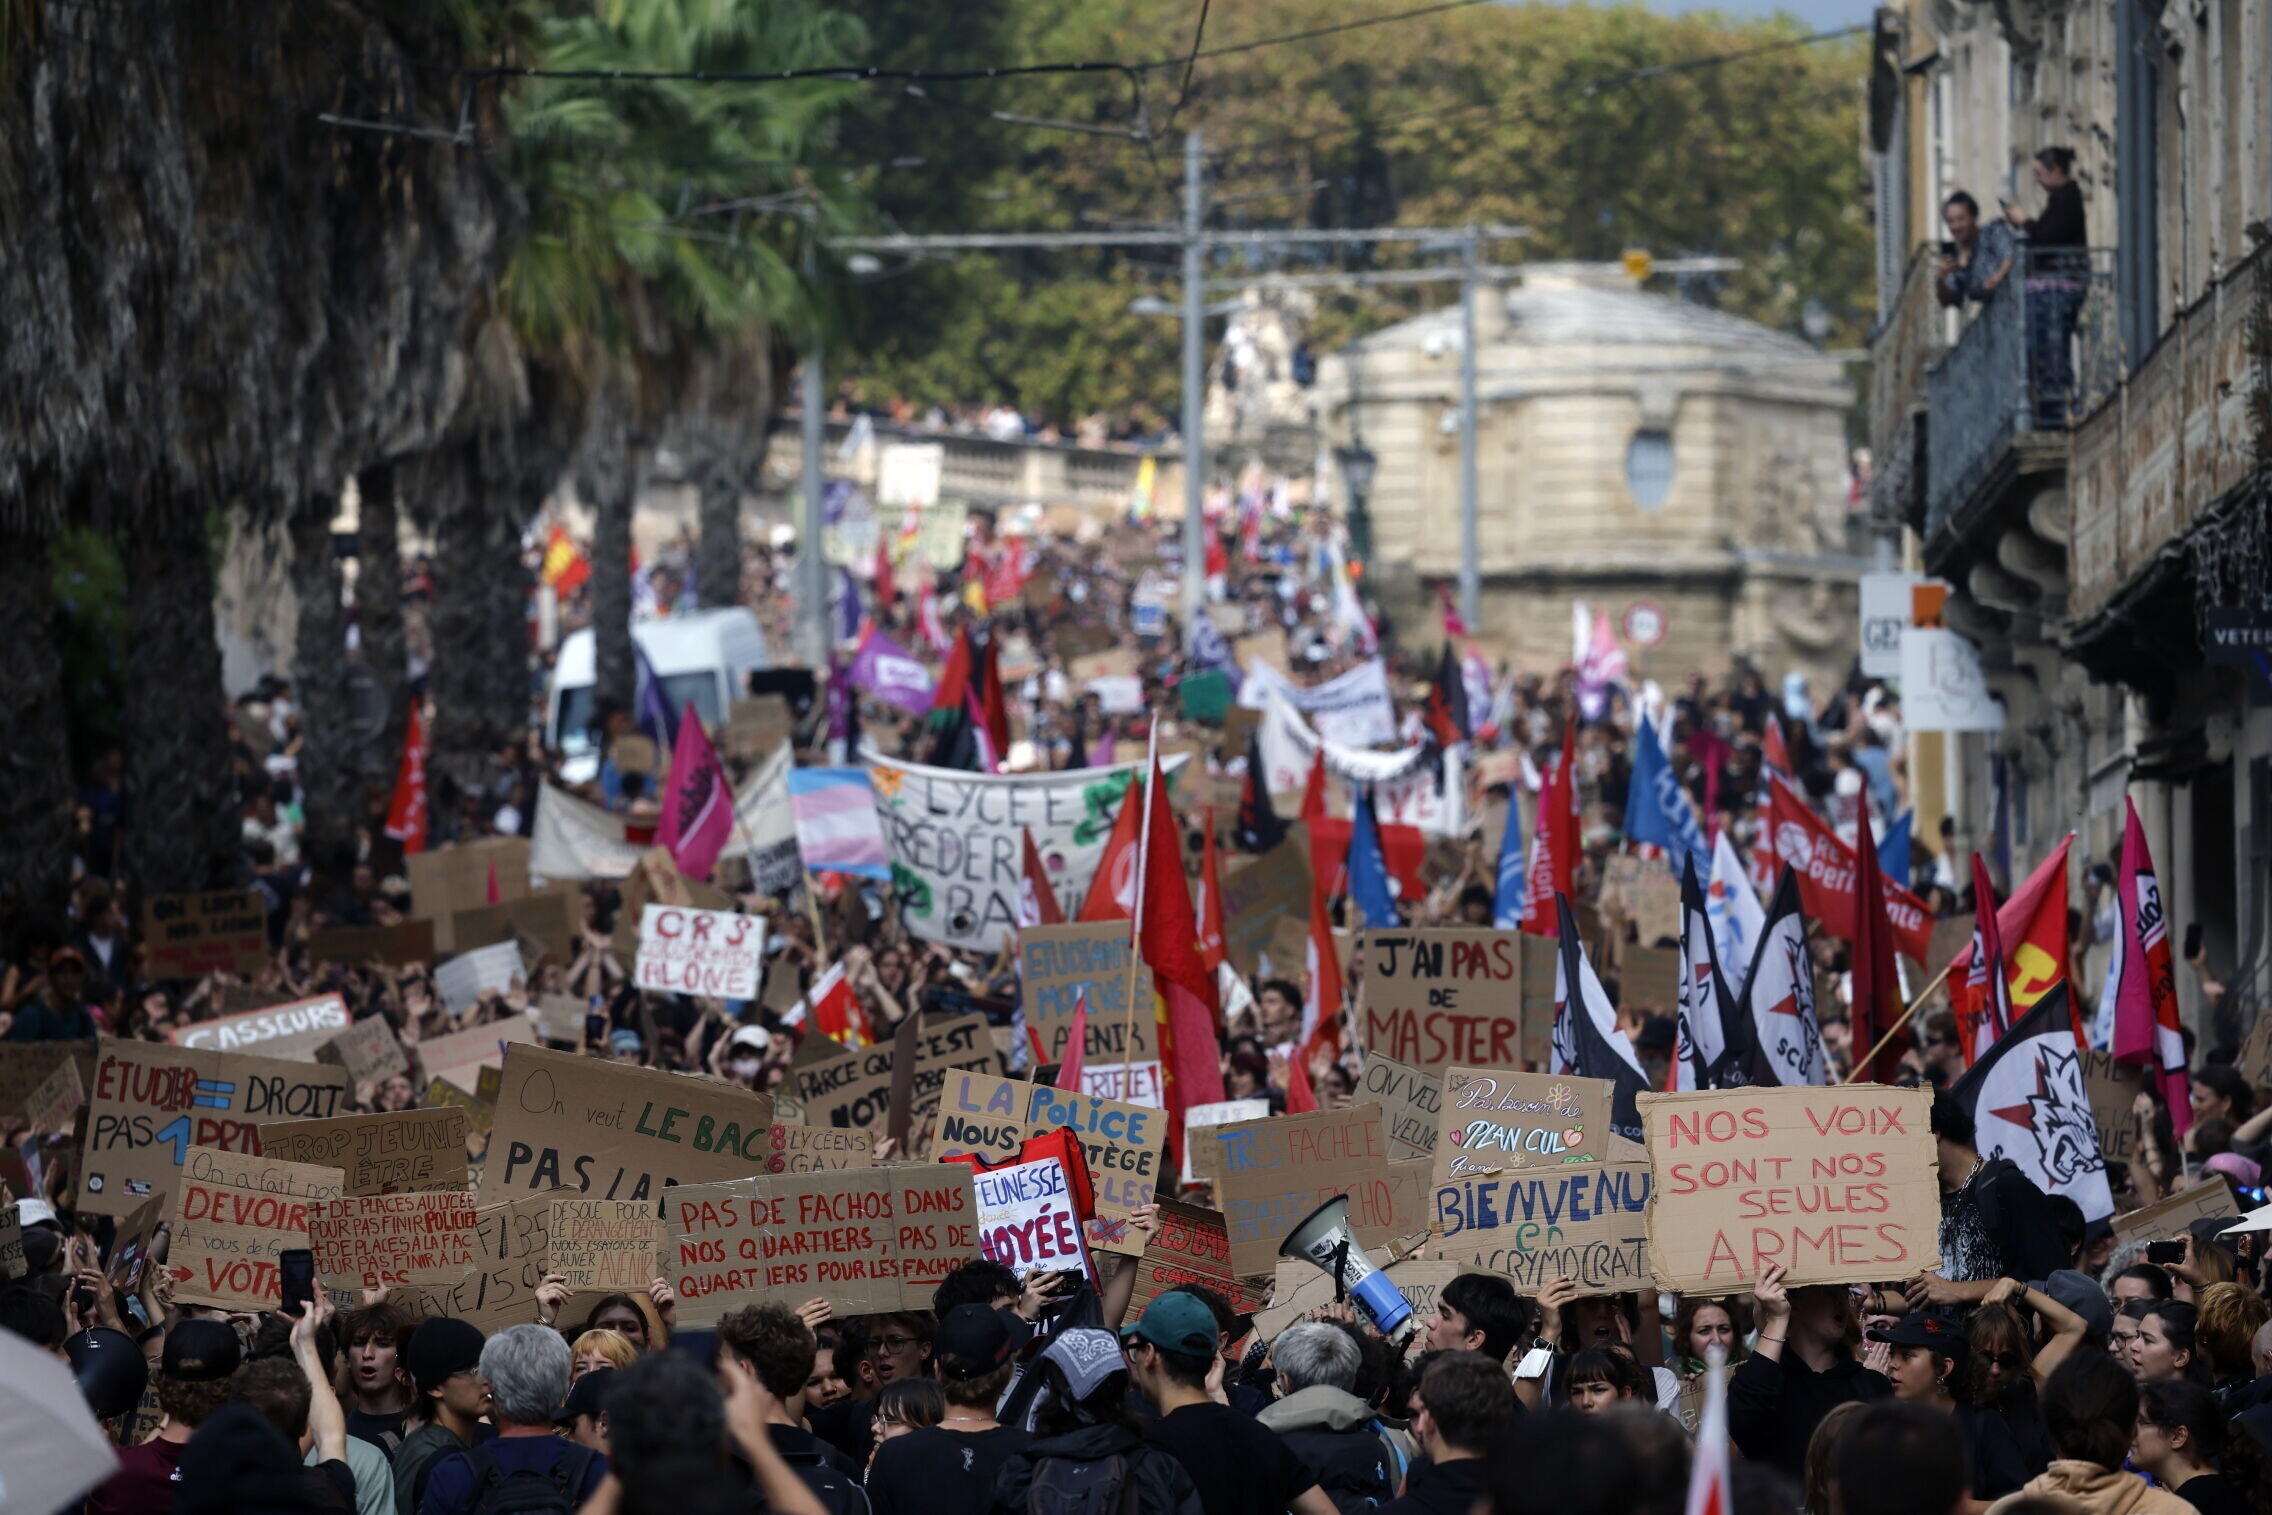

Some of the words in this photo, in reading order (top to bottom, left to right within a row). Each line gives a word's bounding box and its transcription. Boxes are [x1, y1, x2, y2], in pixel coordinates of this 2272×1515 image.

[1374, 937, 1443, 979] J'AI
[1451, 938, 1514, 981] PAS
[1429, 988, 1459, 1008] DE
[185, 999, 347, 1050] CASSEURS
[1053, 1022, 1145, 1058] AENIR
[1368, 1007, 1517, 1065] MASTER
[97, 1055, 198, 1112] ÉTUDIER
[244, 1075, 345, 1118] DROIT
[797, 1060, 858, 1103] PARCE
[959, 1076, 1014, 1117] LA
[1367, 1064, 1405, 1096] ON
[520, 1069, 565, 1115] On
[587, 1102, 625, 1130] veut
[635, 1102, 689, 1143] LE
[692, 1115, 766, 1161] BAC
[1497, 1080, 1551, 1115] besoin
[1561, 1094, 1583, 1118] de
[92, 1114, 154, 1151] PAS
[263, 1128, 351, 1162] TROP
[357, 1116, 466, 1157] JEUNE
[790, 1130, 866, 1151] LYCÉENS
[943, 1116, 1019, 1151] NOUS
[1289, 1112, 1385, 1165] FACHÉE
[1462, 1120, 1521, 1151] PLAN
[1524, 1128, 1567, 1155] CUL
[1669, 1107, 1770, 1148] NOS
[1804, 1105, 1907, 1136] VOIX
[193, 1152, 224, 1184] On
[236, 1173, 251, 1190] a
[260, 1167, 296, 1195] fait
[306, 1183, 341, 1199] nos
[352, 1154, 434, 1190] ÊTRE
[503, 1141, 596, 1193] PAS
[768, 1151, 786, 1173] 6
[1668, 1156, 1793, 1195] SONT
[1812, 1152, 1887, 1179] NOS
[360, 1197, 415, 1215] PLACES
[417, 1196, 437, 1212] AU
[439, 1191, 475, 1211] LYCÉE
[974, 1163, 1066, 1207] EUNESSE
[1104, 1177, 1154, 1209] LES
[1738, 1182, 1890, 1219] SEULES
[309, 1218, 354, 1239] POUR
[353, 1217, 380, 1238] PAS
[382, 1215, 427, 1235] FINIR
[616, 1202, 651, 1220] POUR
[681, 1199, 738, 1234] PAS
[751, 1198, 786, 1227] DE
[799, 1191, 894, 1225] FACHOS
[905, 1187, 965, 1215] DANS
[203, 1236, 240, 1253] vous
[246, 1238, 263, 1256] de
[355, 1236, 410, 1255] PLACES
[424, 1235, 438, 1250] LA
[442, 1234, 473, 1250] FAC
[551, 1241, 582, 1251] NOUS
[587, 1240, 636, 1250] ESSAYONS
[552, 1221, 566, 1238] LE
[680, 1238, 726, 1267] NOS
[900, 1225, 937, 1250] PAS
[948, 1225, 974, 1248] DE
[1515, 1222, 1564, 1252] en
[312, 1257, 354, 1274] POUR
[357, 1255, 390, 1273] PAS
[393, 1252, 437, 1269] FINIR
[453, 1251, 474, 1265] LA
[551, 1252, 596, 1268] SAUVER
[598, 1251, 654, 1287] AVENIR
[817, 1259, 867, 1283] POUR
[870, 1258, 898, 1279] LES
[903, 1255, 972, 1277] FACHOS
[1702, 1223, 1909, 1281] ARMES
[363, 1270, 410, 1287] BAC
